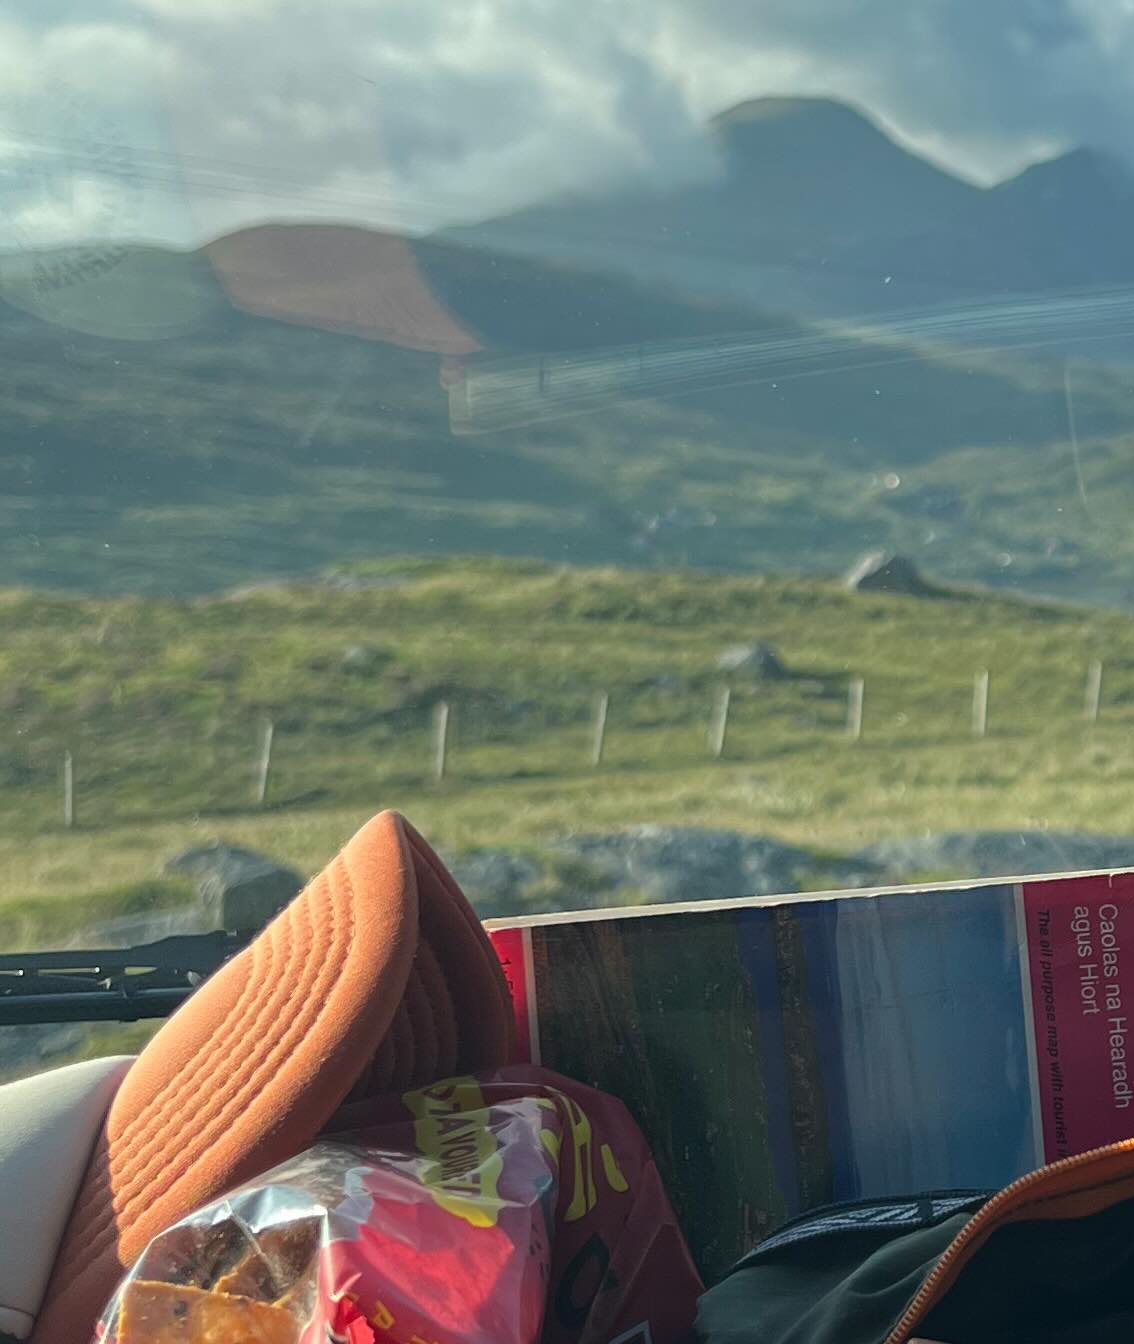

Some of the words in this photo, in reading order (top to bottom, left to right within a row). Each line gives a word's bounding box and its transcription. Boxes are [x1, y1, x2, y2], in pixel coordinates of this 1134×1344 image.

[1037, 911, 1050, 937] The
[1071, 906, 1093, 957] agus
[1098, 903, 1121, 977] Caolas
[1039, 940, 1053, 957] all
[1040, 960, 1056, 1021] purpose
[1079, 964, 1100, 1016] Hiort
[1104, 982, 1122, 1011] na
[1046, 1025, 1059, 1057] map
[1106, 1016, 1132, 1109] Hearadh
[1050, 1061, 1063, 1093] with
[1053, 1097, 1067, 1145] tourist
